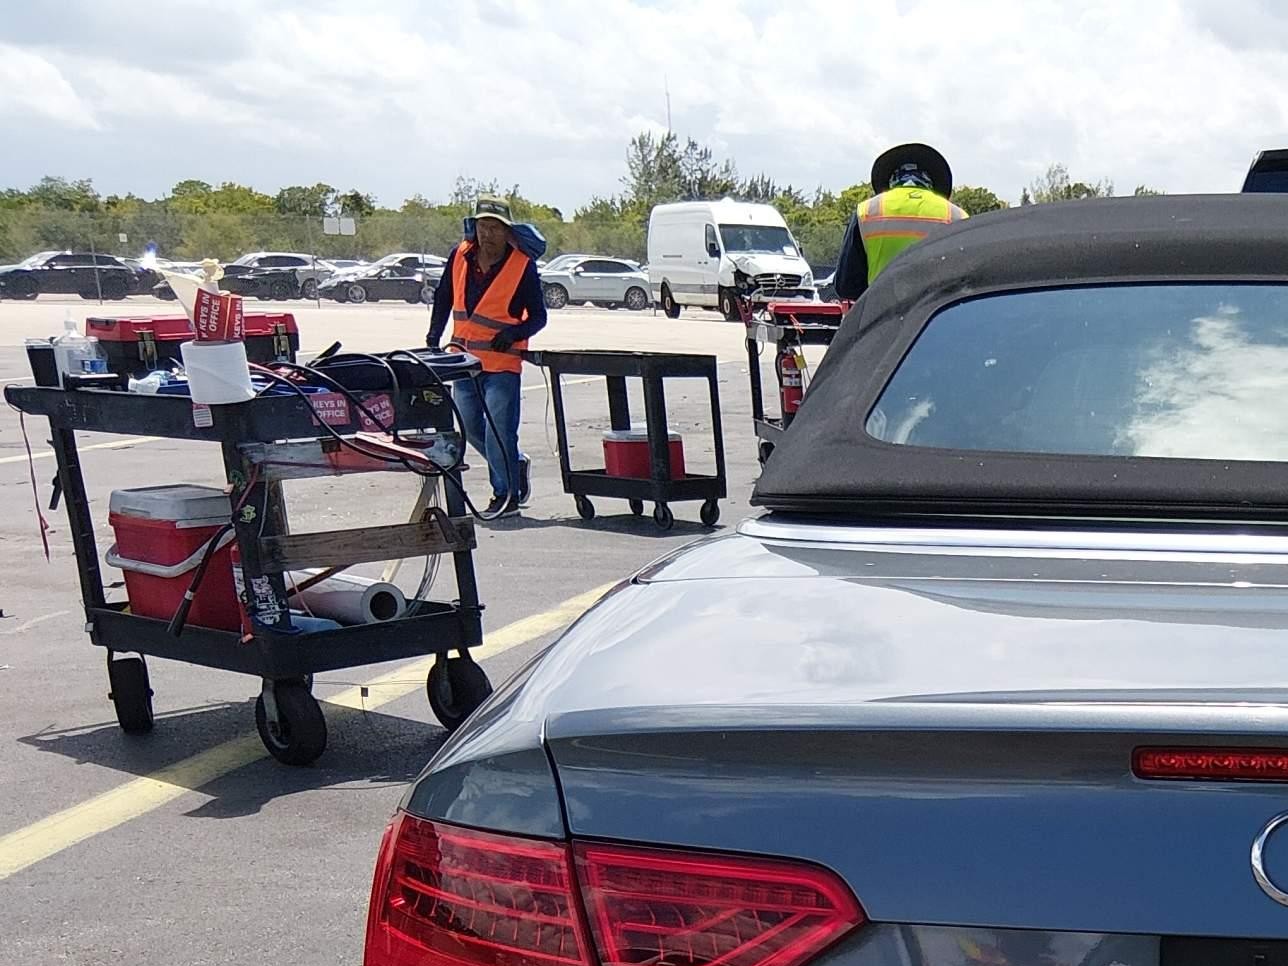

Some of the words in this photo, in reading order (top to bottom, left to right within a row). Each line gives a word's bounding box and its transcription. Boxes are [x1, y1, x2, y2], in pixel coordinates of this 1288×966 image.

[202, 293, 210, 305] IN
[200, 305, 209, 331] KEYS
[209, 299, 220, 332] OFFICE
[337, 399, 346, 408] IN
